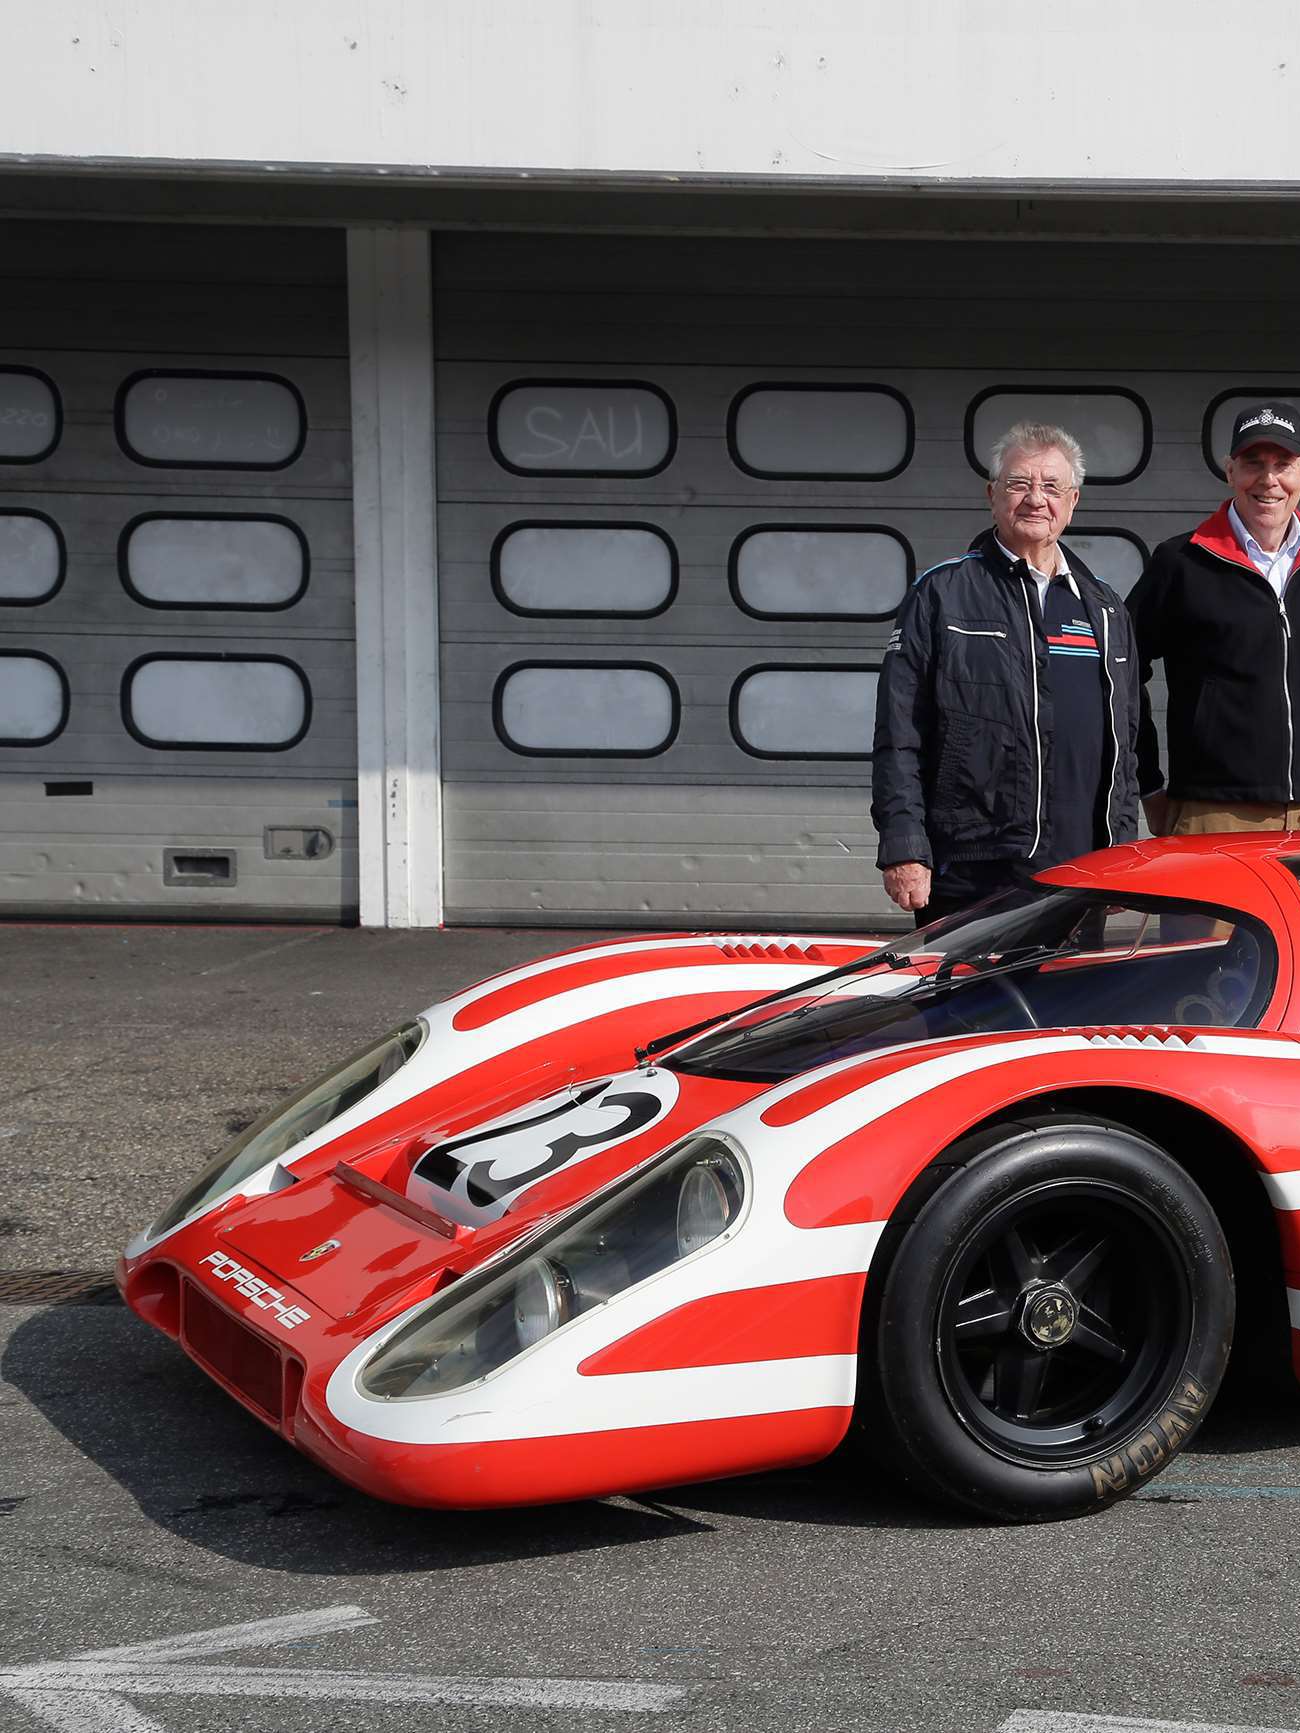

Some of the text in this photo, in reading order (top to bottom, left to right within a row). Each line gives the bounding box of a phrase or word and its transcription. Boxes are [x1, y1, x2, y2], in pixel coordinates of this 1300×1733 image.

[515, 405, 643, 463] SAU
[414, 1078, 662, 1208] 23
[198, 1250, 312, 1330] PORSCHE
[1089, 1371, 1210, 1500] AVON
